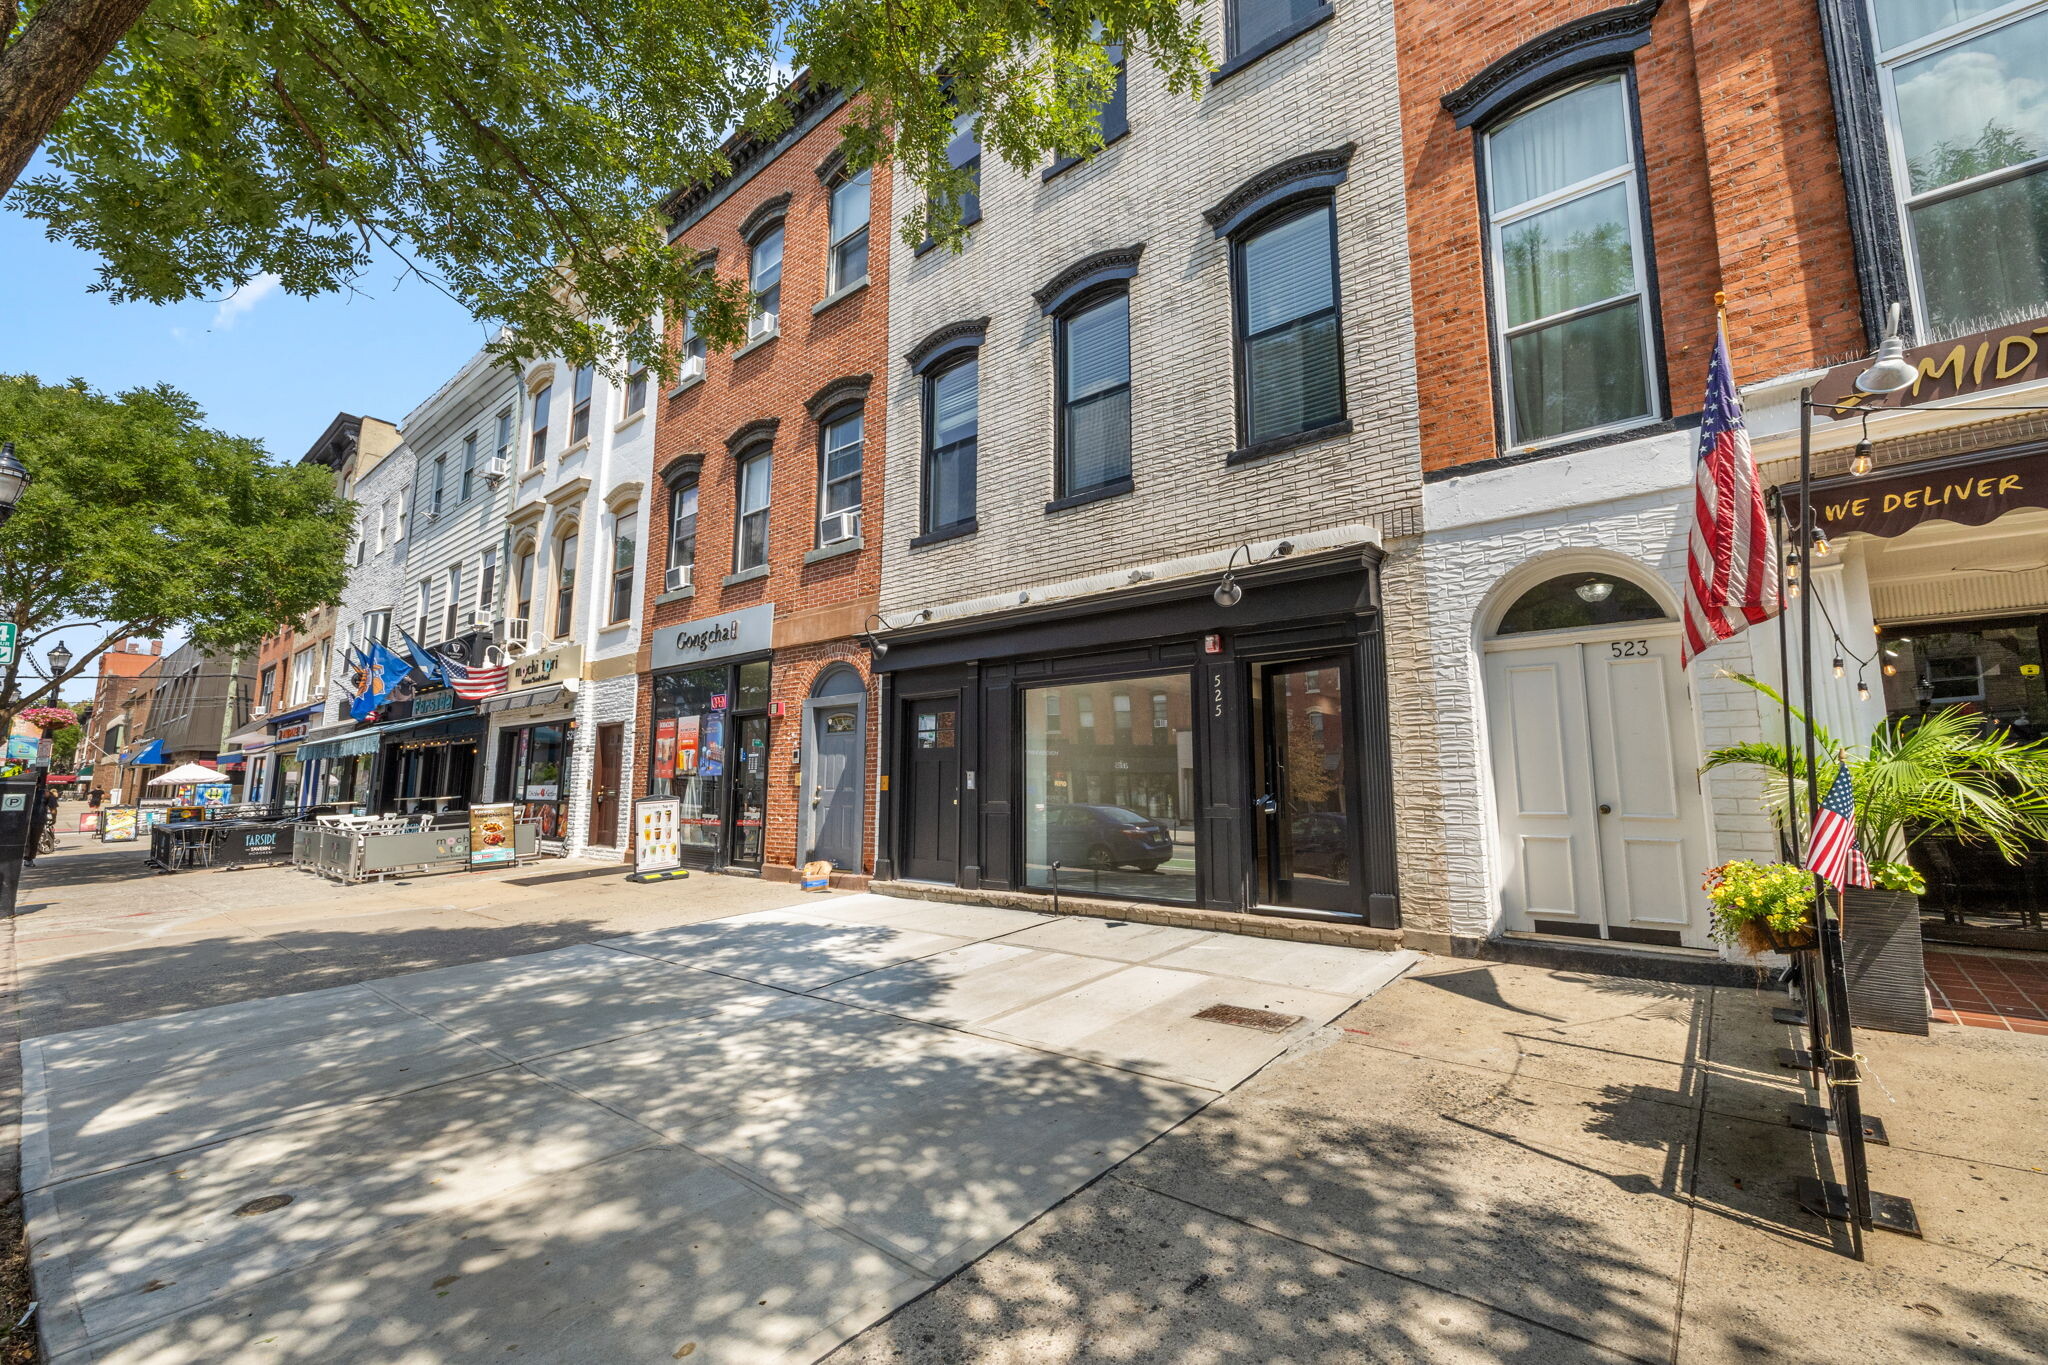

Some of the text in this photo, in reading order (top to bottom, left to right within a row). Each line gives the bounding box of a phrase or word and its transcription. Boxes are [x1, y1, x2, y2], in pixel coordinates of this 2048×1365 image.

[1825, 474, 2024, 522] WE DELIVER
[1611, 640, 1648, 658] 523
[515, 655, 559, 678] mochi tori
[246, 833, 277, 846] FARSIDE
[436, 834, 469, 845] moch
